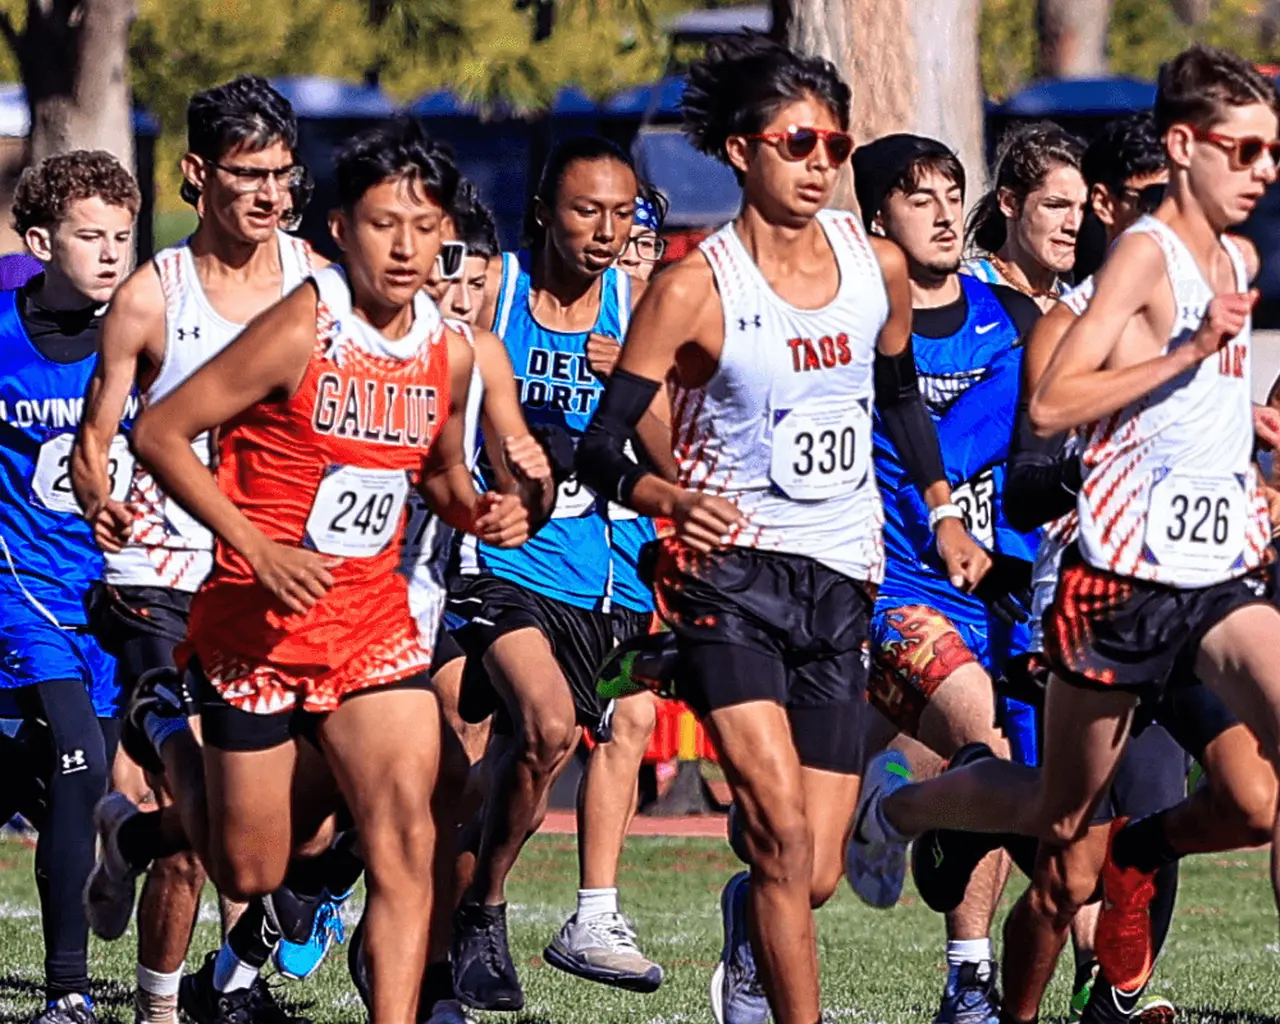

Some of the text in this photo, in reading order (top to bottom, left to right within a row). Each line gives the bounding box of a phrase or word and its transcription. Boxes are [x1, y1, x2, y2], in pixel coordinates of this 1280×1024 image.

[528, 347, 601, 385] DEL
[787, 333, 854, 373] TAOS
[312, 372, 438, 450] GALLUP
[516, 376, 605, 416] ORT
[793, 426, 856, 477] 330
[328, 490, 394, 536] 249
[1166, 494, 1231, 545] 326
